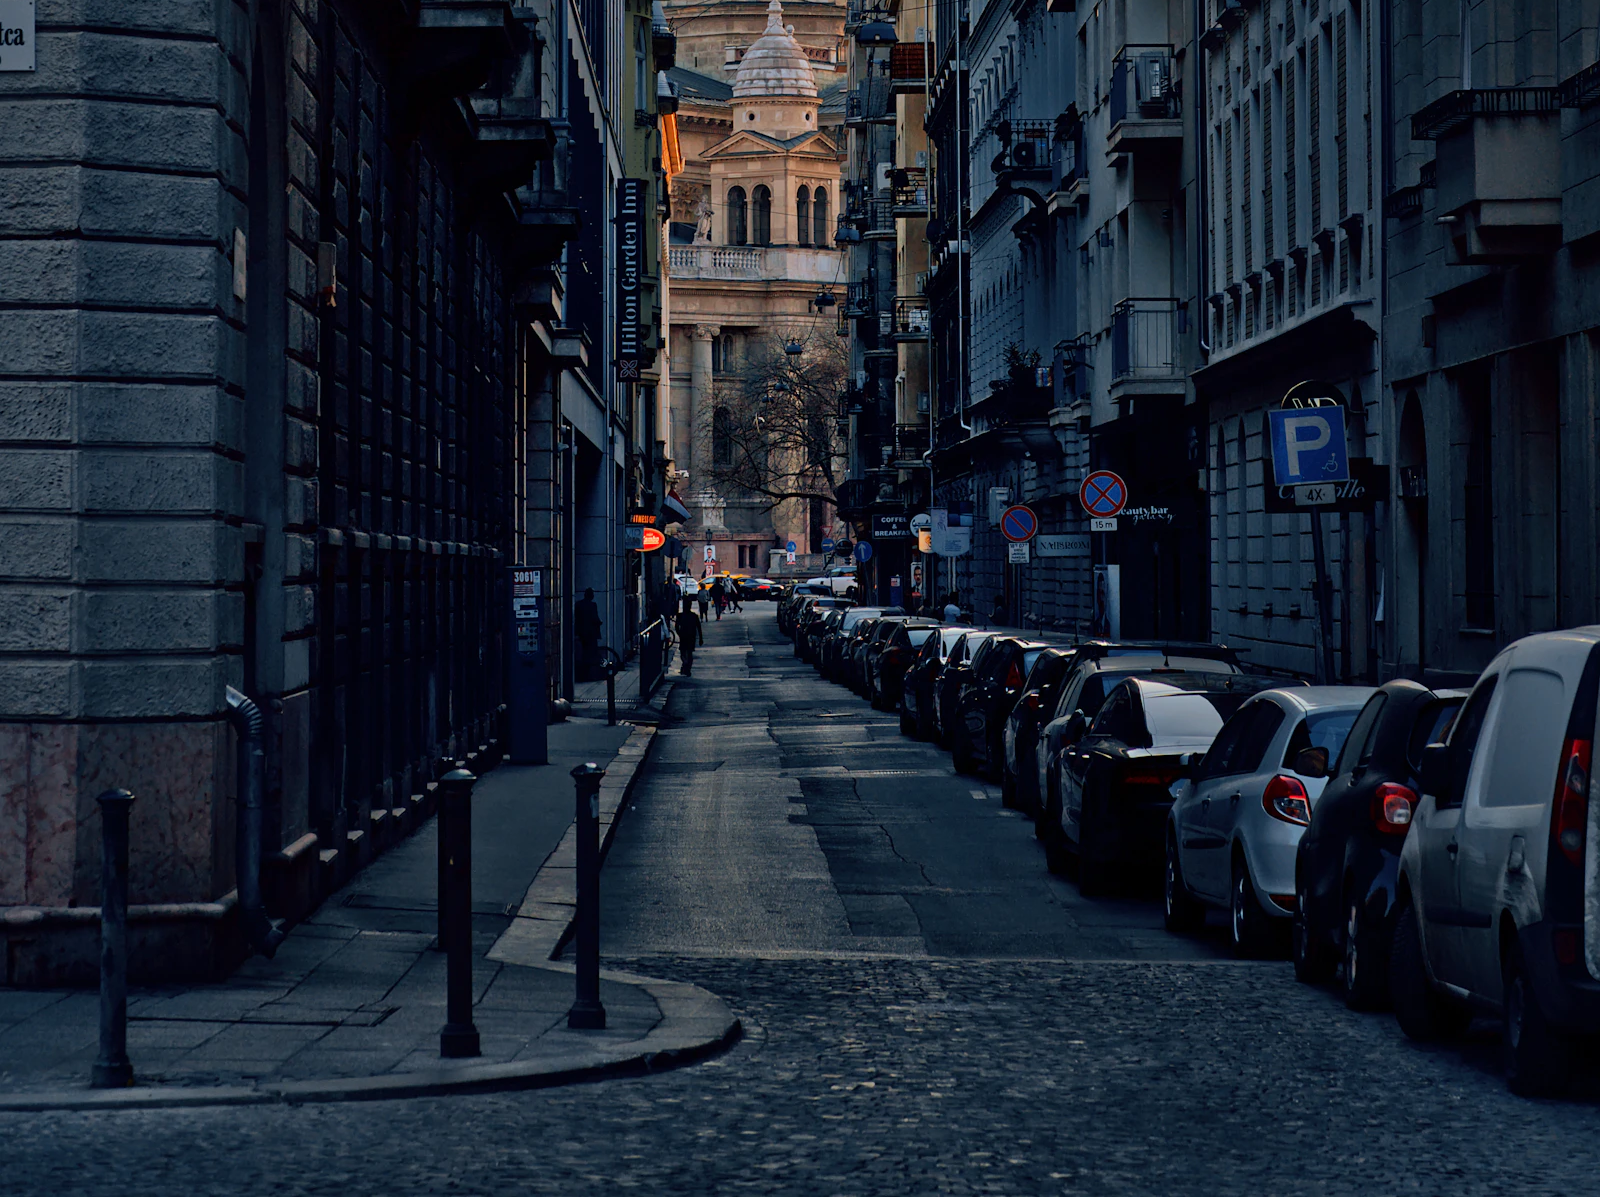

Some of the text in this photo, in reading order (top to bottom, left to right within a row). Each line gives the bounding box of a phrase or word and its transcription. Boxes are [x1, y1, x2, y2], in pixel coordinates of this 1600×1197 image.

[621, 182, 637, 354] Hilton Garden Inn
[1283, 415, 1331, 477] P
[1307, 488, 1323, 502] 4X
[1118, 505, 1169, 516] eauty bar
[1095, 521, 1104, 529] 15
[874, 529, 911, 537] BREAKFAS
[513, 571, 533, 583] 3061
